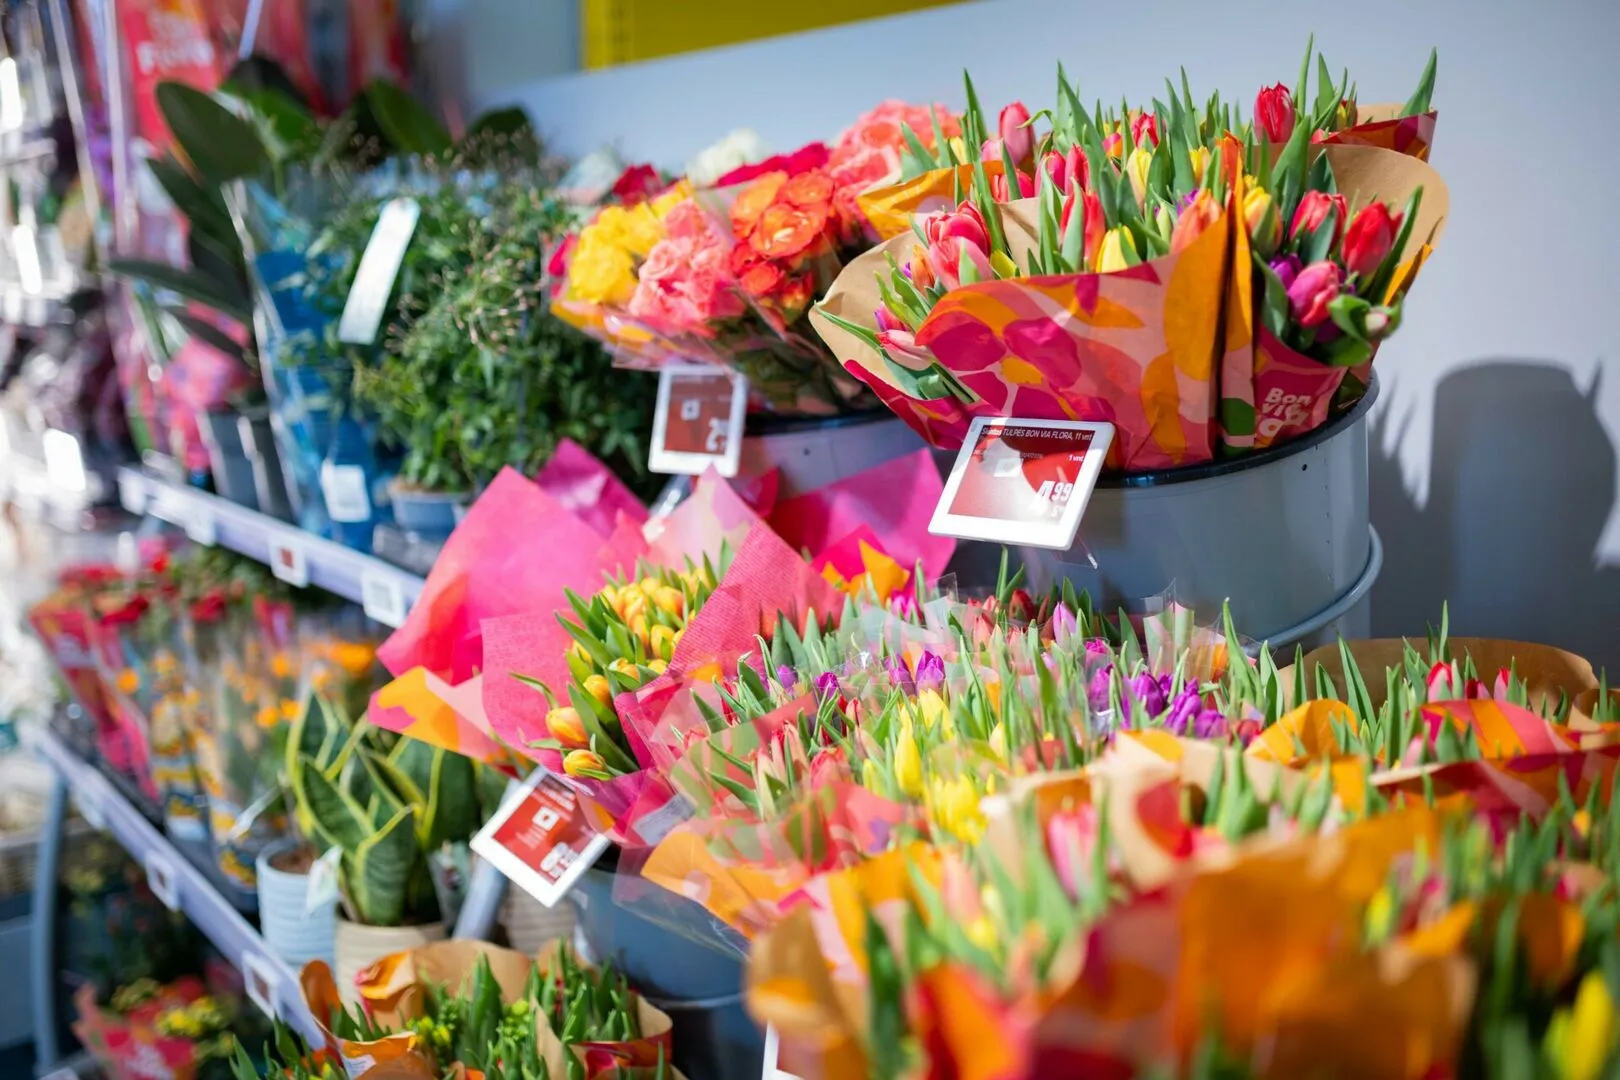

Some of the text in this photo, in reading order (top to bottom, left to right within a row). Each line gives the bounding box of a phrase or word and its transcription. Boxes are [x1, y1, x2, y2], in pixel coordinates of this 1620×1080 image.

[1265, 387, 1311, 406] Bon
[1025, 430, 1040, 438] BON
[1041, 431, 1052, 439] VIA
[1075, 432, 1082, 440] 11
